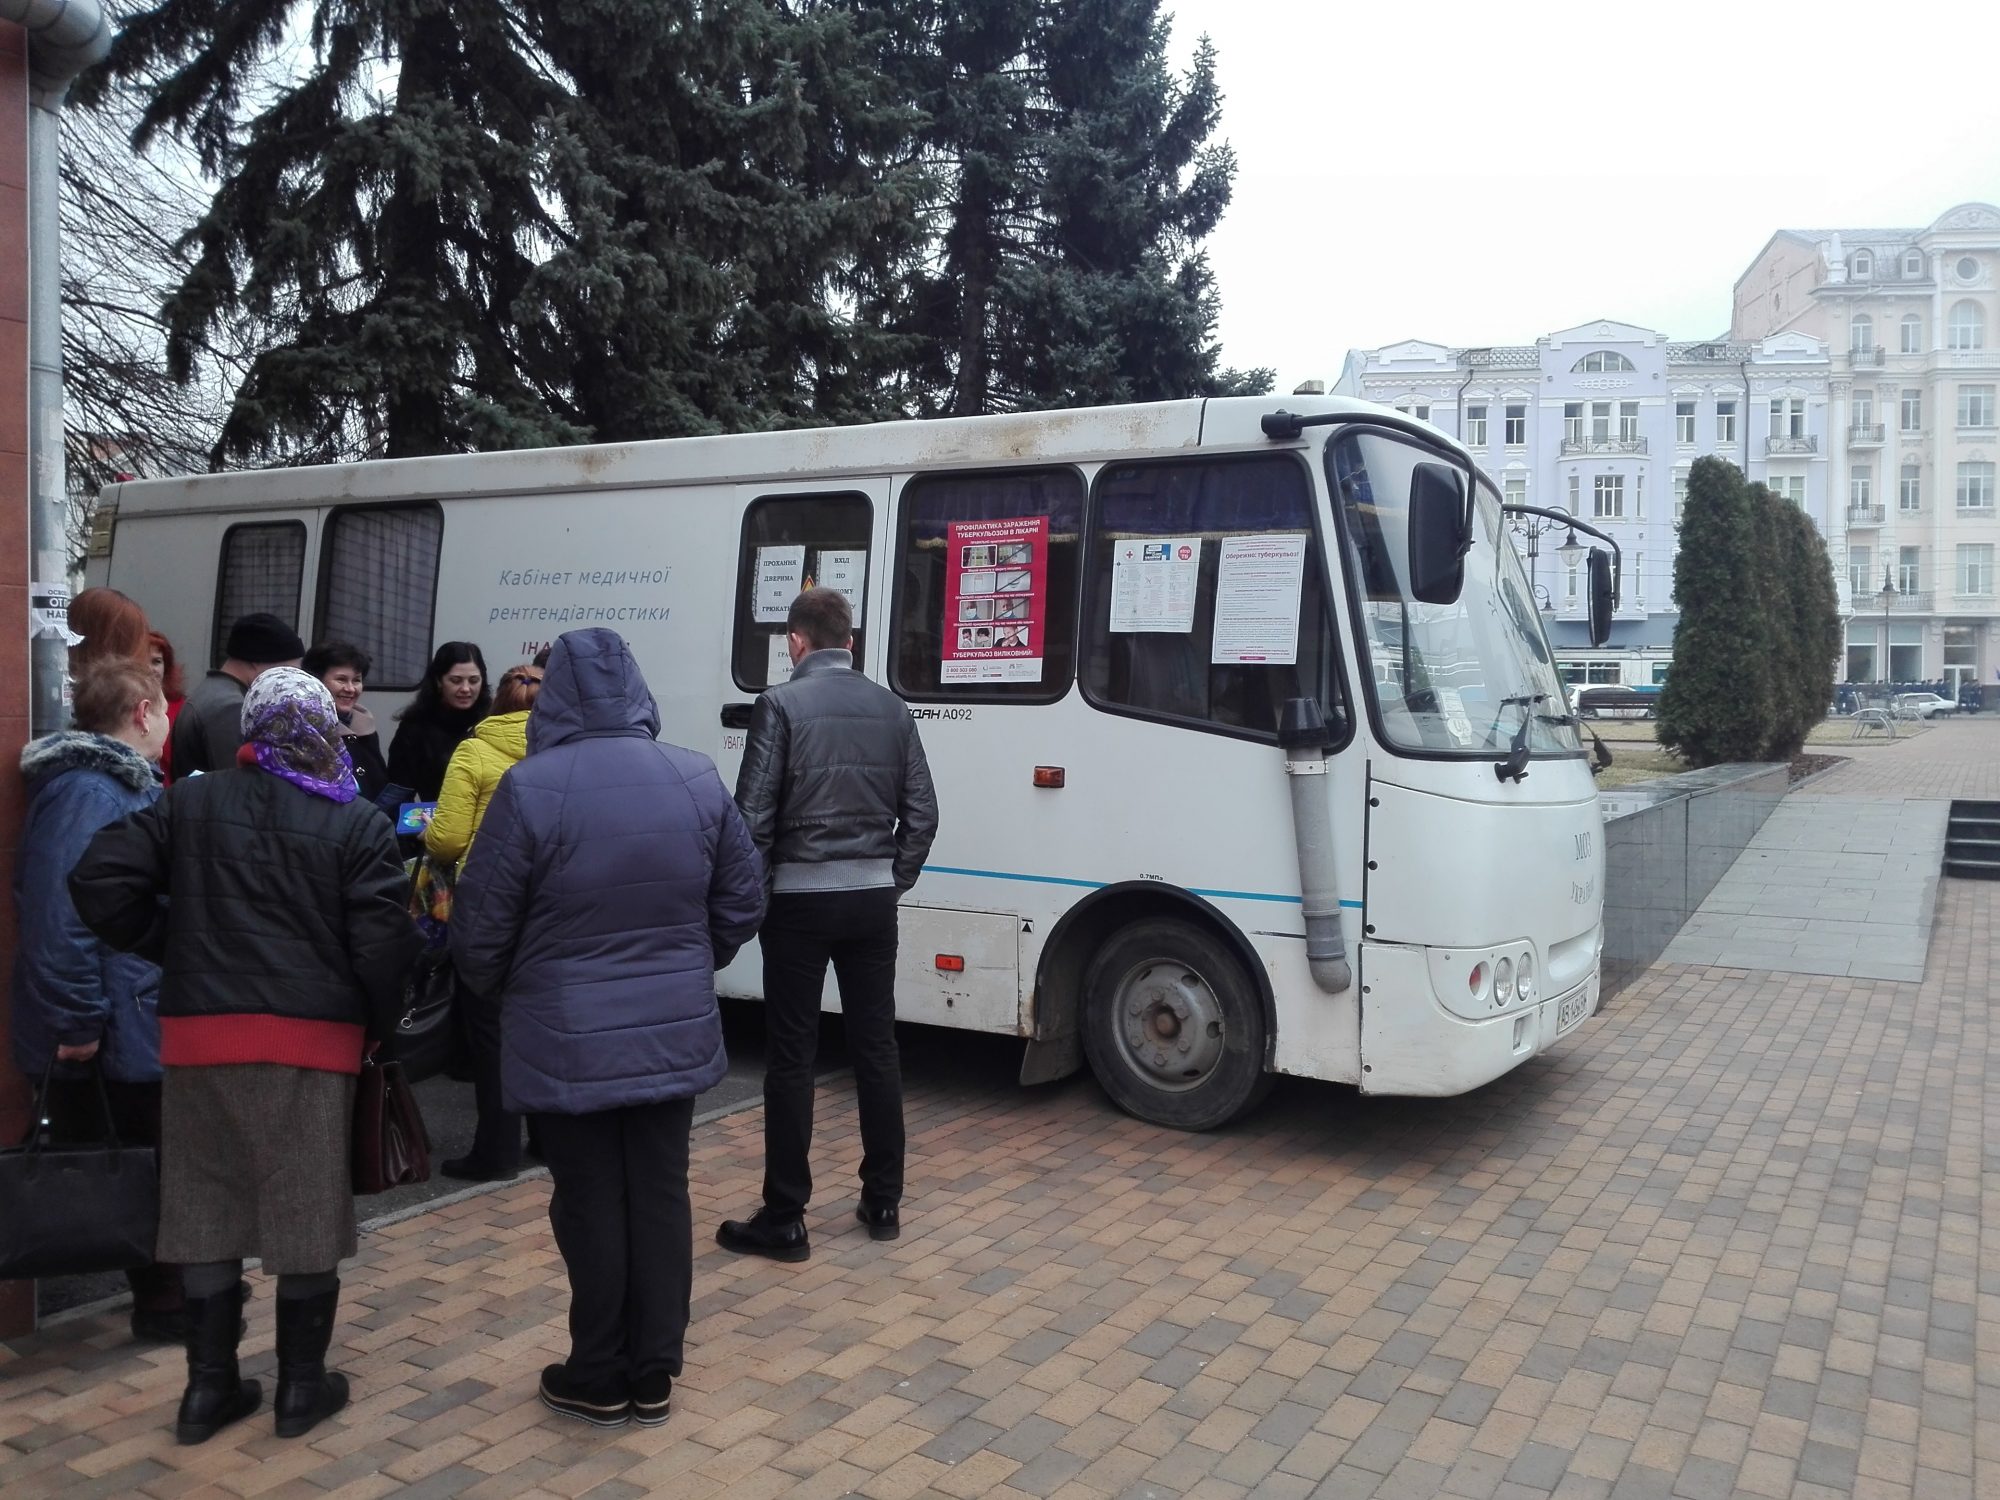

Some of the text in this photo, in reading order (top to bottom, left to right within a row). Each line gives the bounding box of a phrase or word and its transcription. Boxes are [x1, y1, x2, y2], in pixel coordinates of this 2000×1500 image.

[955, 519, 1041, 532] ПРОФІЛАКТИКА ЗАРАЖЕННЯ
[957, 529, 1009, 539] ТУБЕРКУЛЬОЗОМ
[763, 559, 797, 567] ПРОХАННЯ
[499, 566, 672, 587] Кабінет медичної
[488, 604, 671, 624] рентгендіагностики
[953, 651, 993, 659] ТУБЕРКУЛЬОЗ
[942, 708, 973, 721] А092
[723, 735, 745, 750] УВАГА
